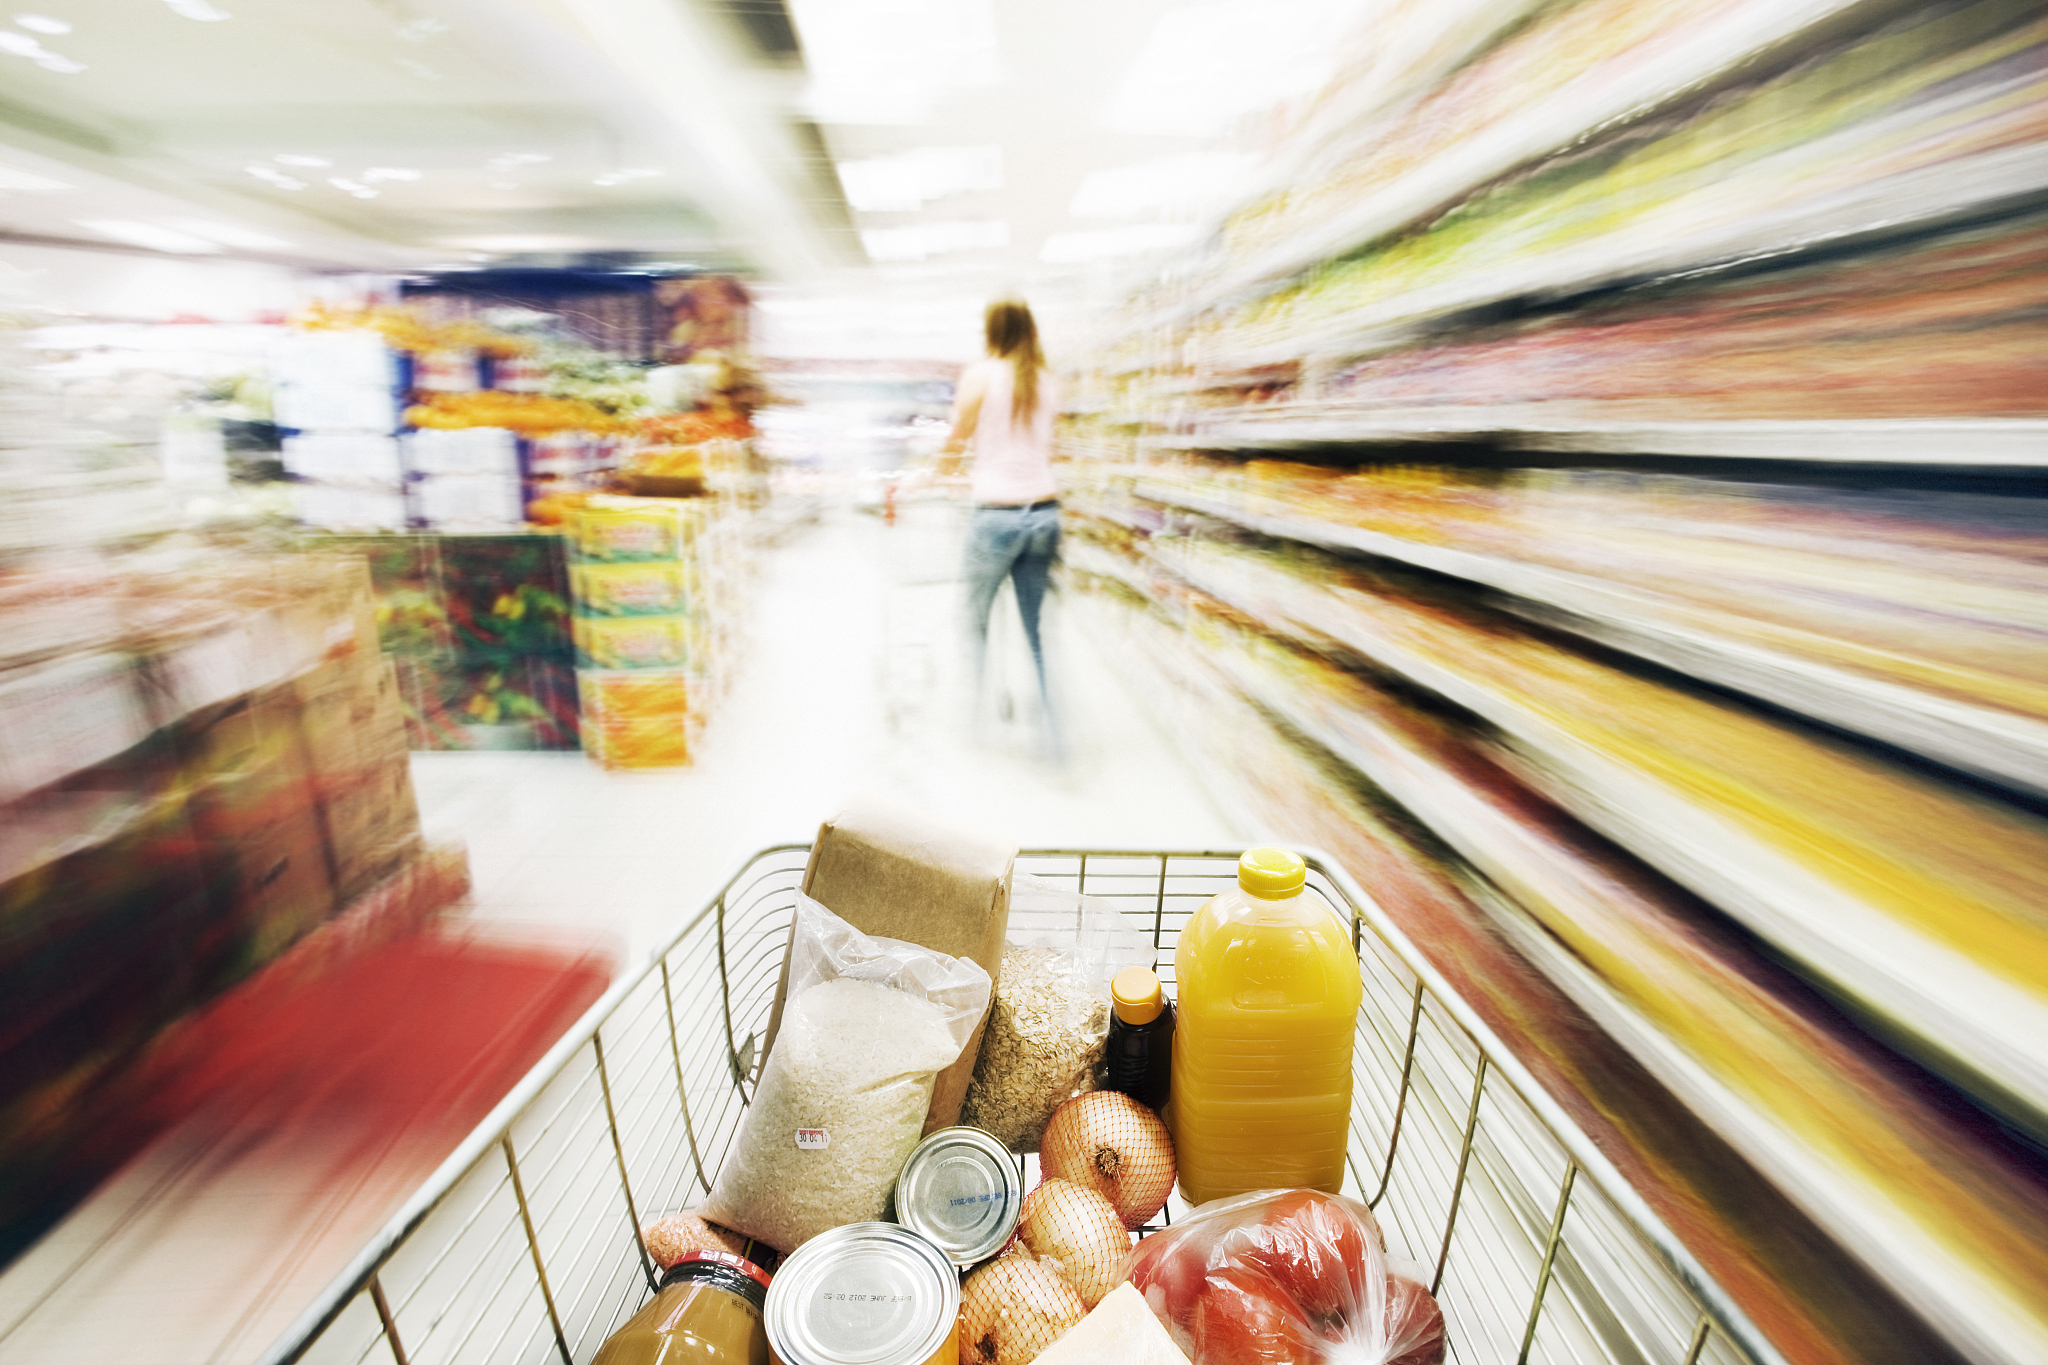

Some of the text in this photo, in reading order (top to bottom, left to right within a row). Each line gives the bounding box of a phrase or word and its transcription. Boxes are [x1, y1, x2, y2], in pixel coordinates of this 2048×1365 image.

[799, 1133, 807, 1143] 30
[848, 1294, 867, 1302] 2012
[870, 1294, 887, 1302] JUNE
